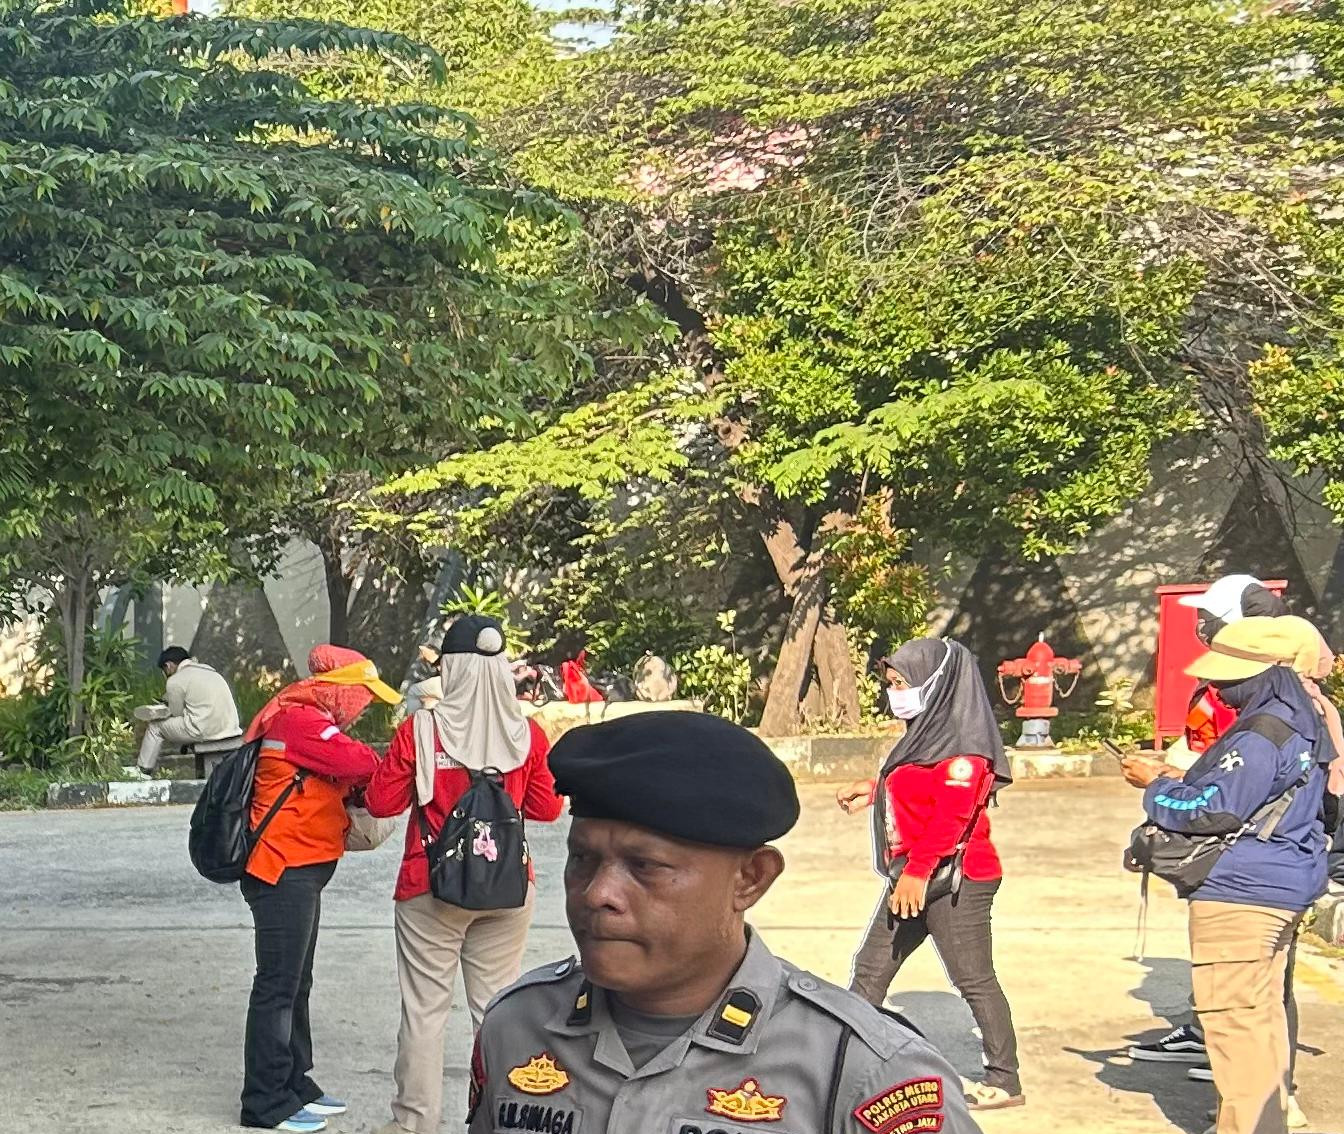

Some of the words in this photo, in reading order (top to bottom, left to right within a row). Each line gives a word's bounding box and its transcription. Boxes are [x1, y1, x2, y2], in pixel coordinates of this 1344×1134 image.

[862, 1089, 904, 1120] POLRES
[904, 1081, 939, 1098] METRO
[872, 1099, 911, 1127] JAKARTA
[915, 1117, 937, 1128] JAYA
